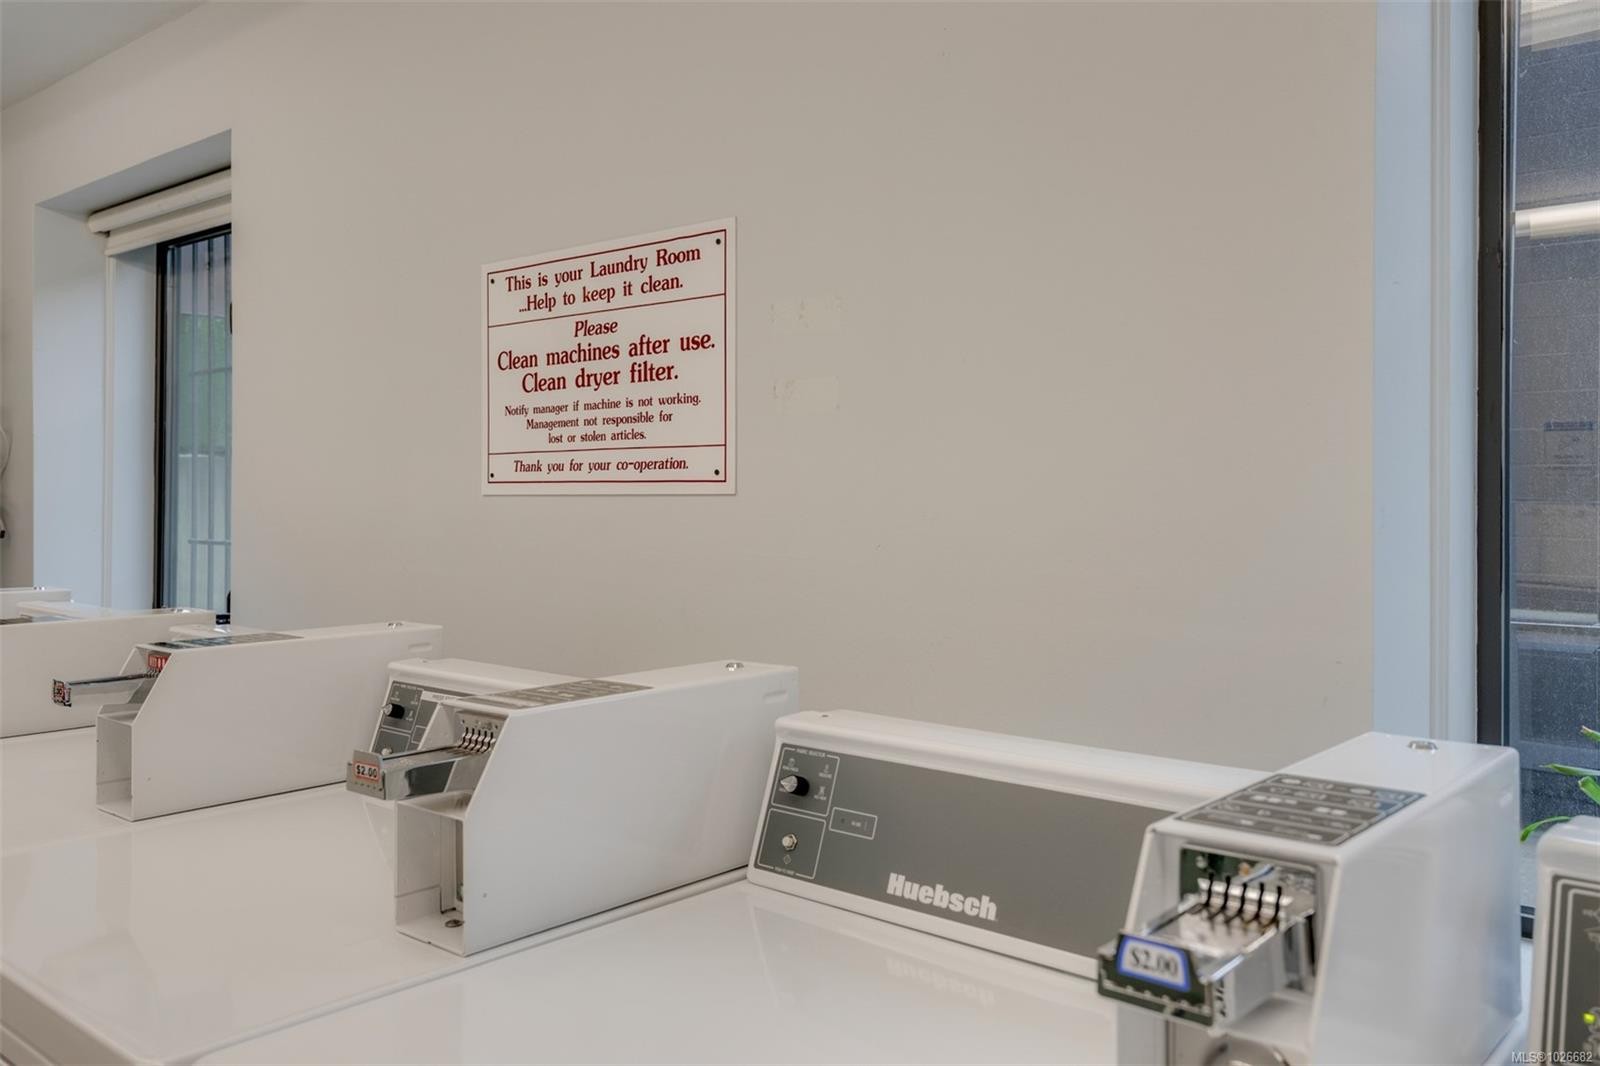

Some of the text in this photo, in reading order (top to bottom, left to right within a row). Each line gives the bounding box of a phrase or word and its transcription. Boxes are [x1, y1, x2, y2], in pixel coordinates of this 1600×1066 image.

[505, 247, 701, 292] This is your Laundry Room
[519, 275, 684, 313] ...Help to keep it clean.
[574, 320, 618, 338] Please
[497, 332, 716, 371] Clean machines after use.
[522, 361, 679, 393] Clean dryer filter.
[504, 393, 702, 417] Notify manager if machine is not working.
[526, 411, 673, 431] Management not responsible for
[548, 428, 647, 444] lost or stolen articles.
[513, 457, 689, 474] Thank you for your co-operation.
[356, 764, 378, 778] $2.00
[886, 872, 997, 921] Huebsch
[1129, 946, 1179, 977] $2.00
